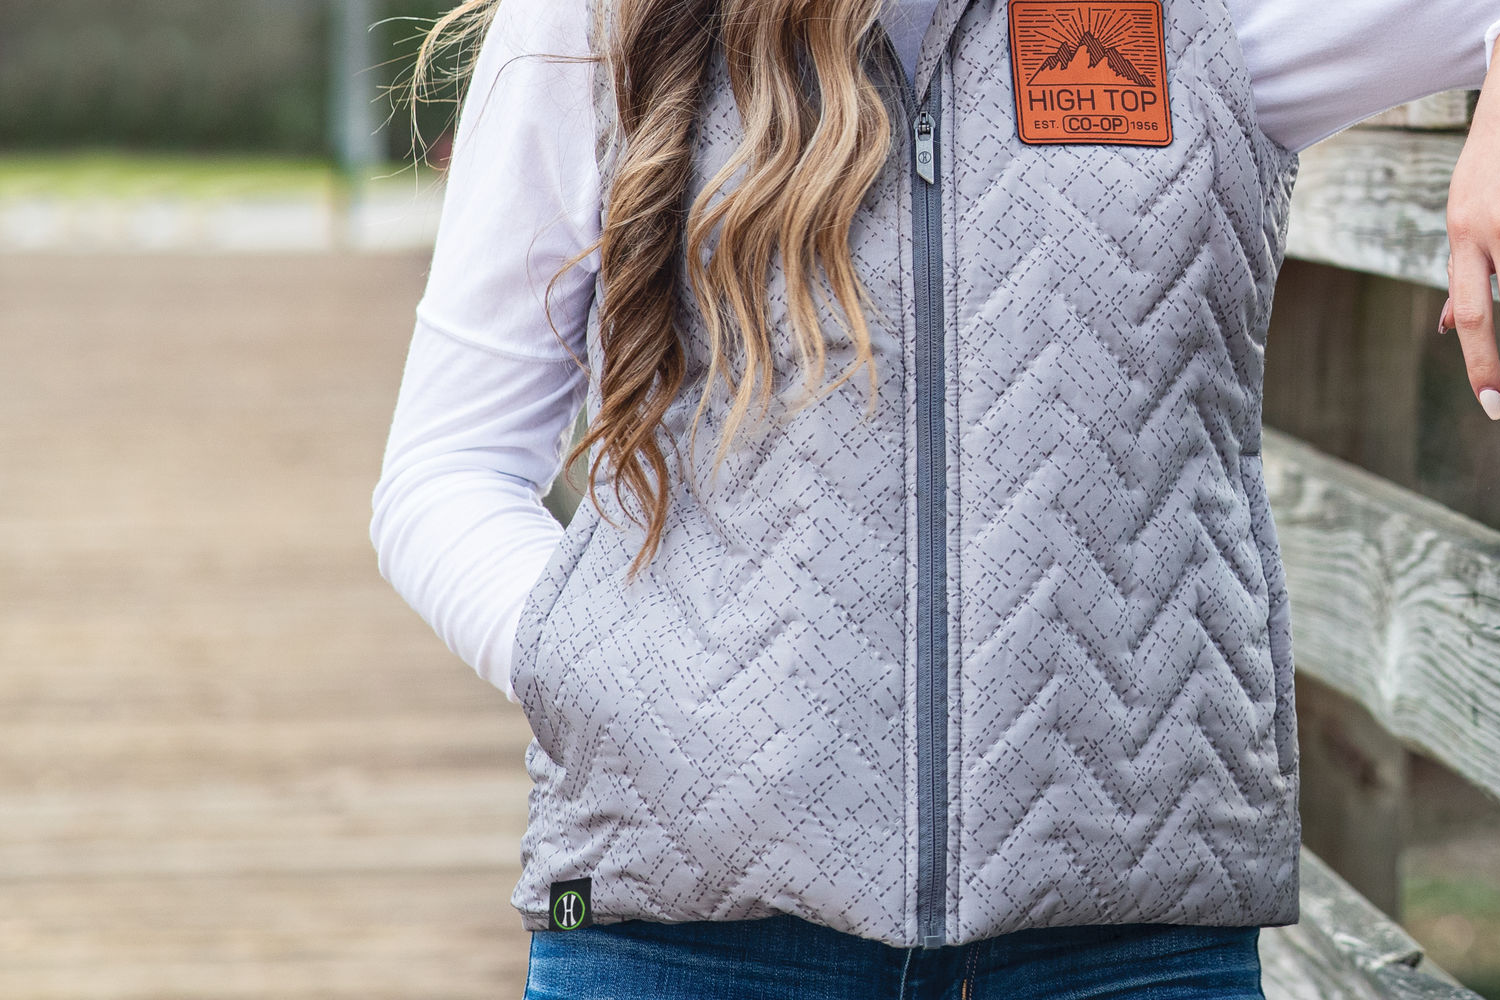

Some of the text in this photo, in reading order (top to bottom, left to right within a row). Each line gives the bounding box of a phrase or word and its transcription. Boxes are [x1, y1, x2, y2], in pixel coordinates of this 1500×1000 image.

[1028, 89, 1158, 113] HIGH TOP
[1034, 117, 1159, 132] EST. CO-OP 1956
